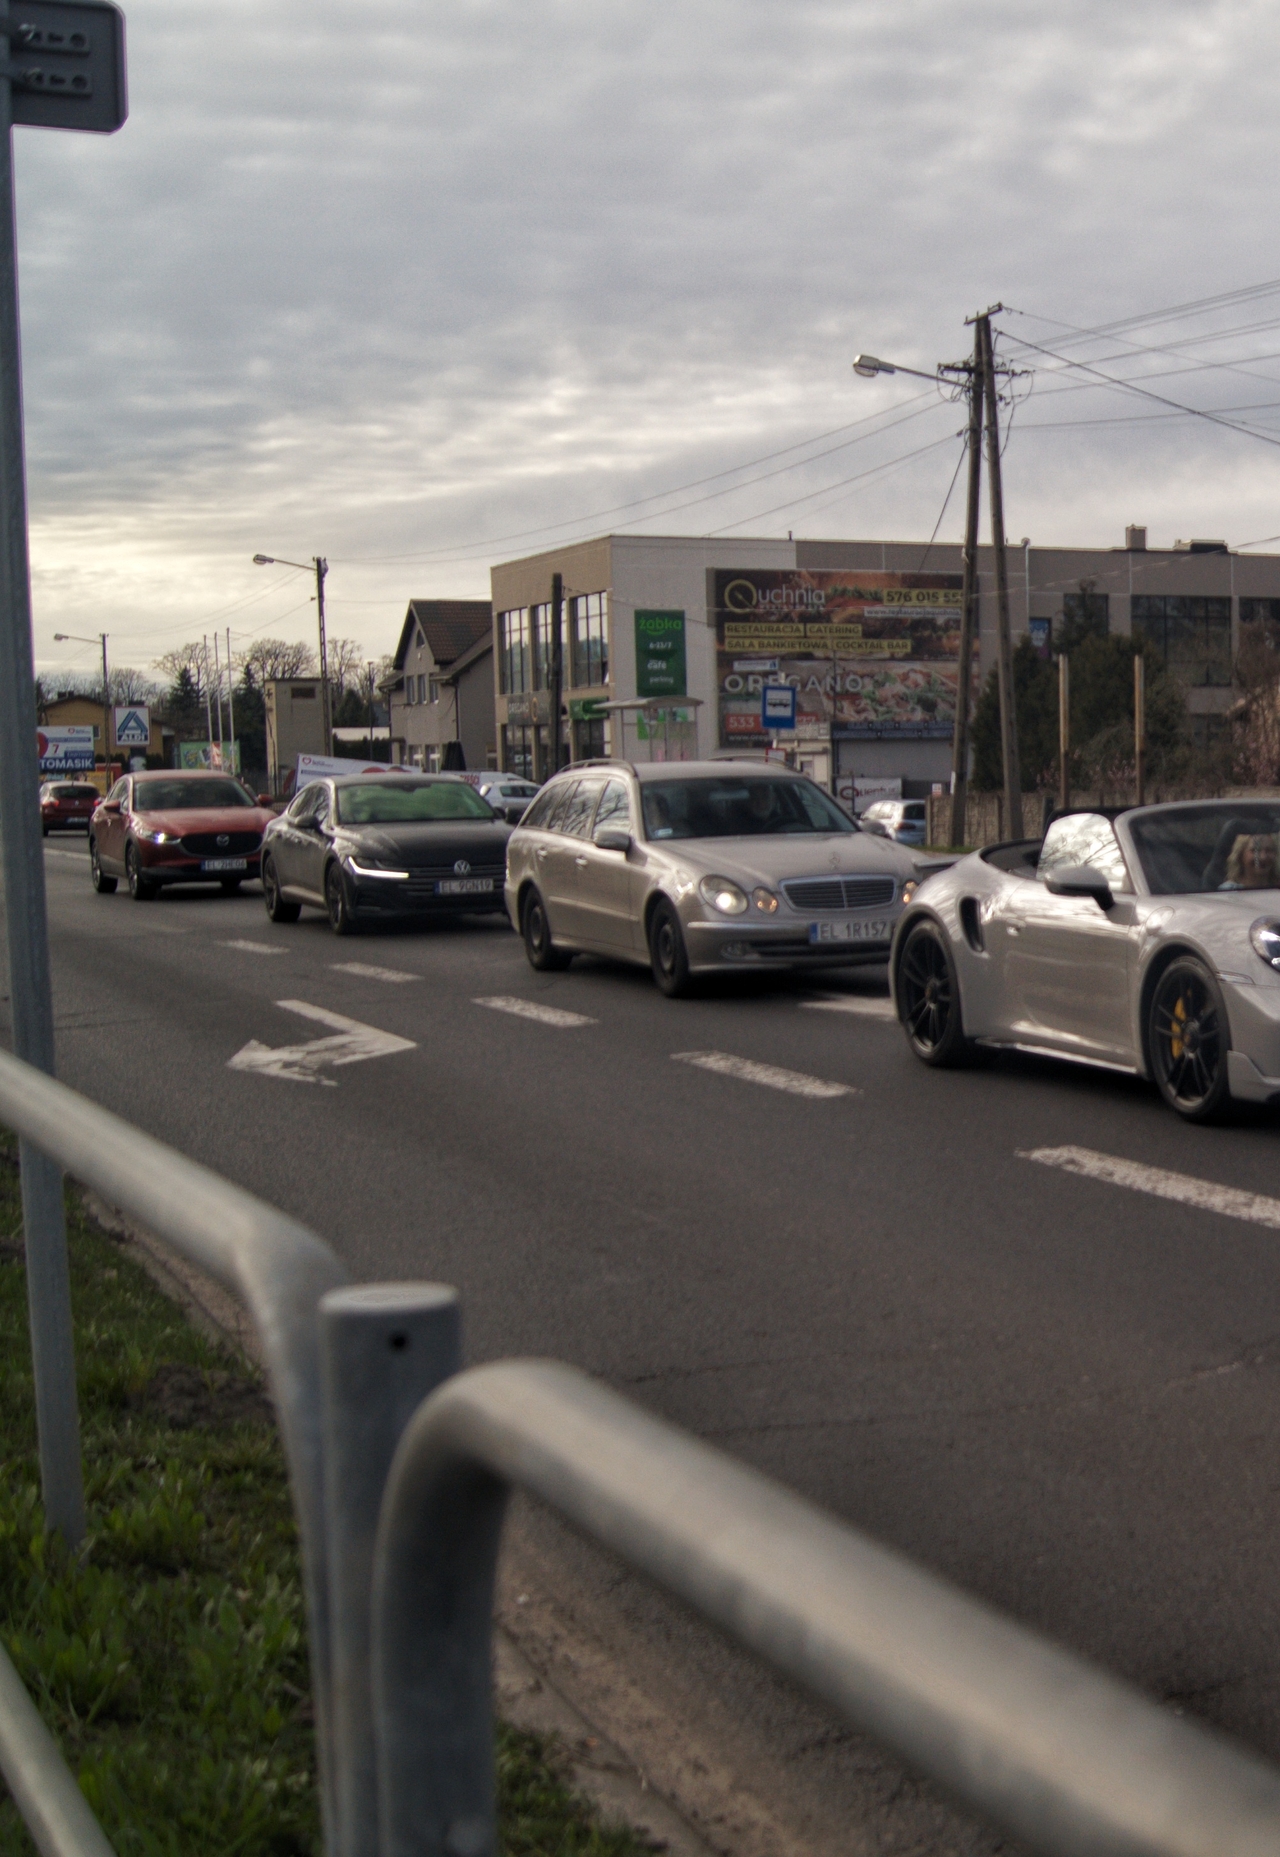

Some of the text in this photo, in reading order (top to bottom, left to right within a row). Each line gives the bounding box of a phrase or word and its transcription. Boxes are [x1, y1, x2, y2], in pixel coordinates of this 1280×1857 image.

[724, 579, 826, 614] Quchnia
[886, 591, 912, 602] 576
[916, 591, 939, 601] 015
[726, 625, 860, 634] RESTAURACJA CATERING
[727, 640, 908, 649] SALA BANKIETOWA COCKTAIL BAR
[729, 716, 755, 729] 533
[120, 732, 145, 741] ALDI
[53, 744, 60, 755] 7
[40, 758, 93, 769] TOMASIK
[820, 921, 887, 939] EL 1R157
